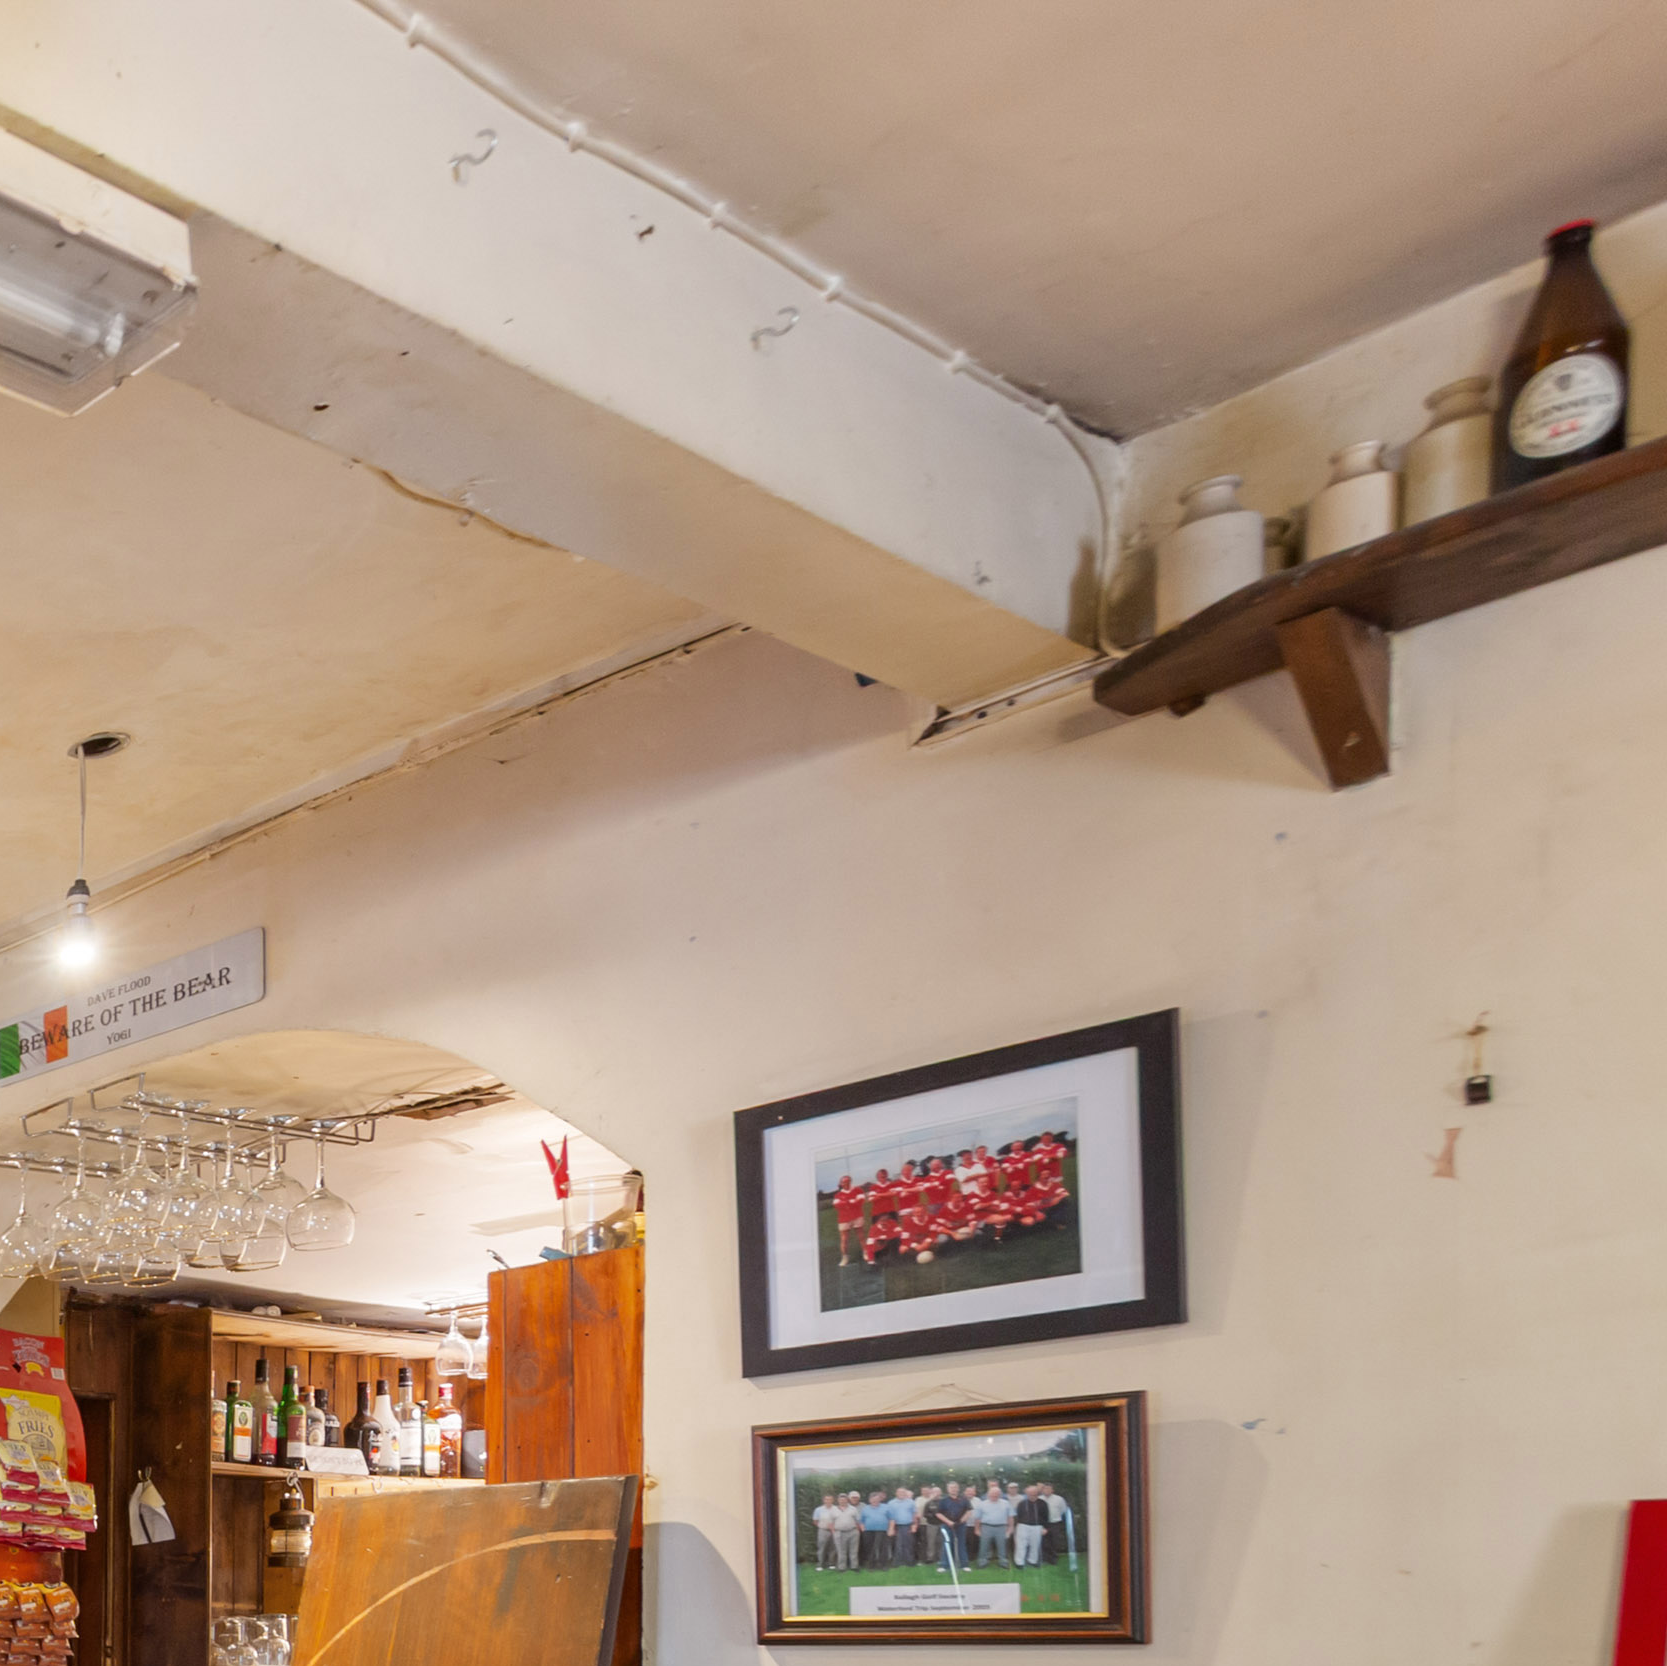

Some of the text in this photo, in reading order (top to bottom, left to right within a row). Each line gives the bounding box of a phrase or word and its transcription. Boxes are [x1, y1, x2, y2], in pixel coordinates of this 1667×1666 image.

[87, 975, 152, 1007] DAVE FLOOD
[18, 966, 232, 1055] BEWARE OF THE BEAR
[106, 1028, 132, 1046] YOGI
[17, 1420, 54, 1439] FRIES
